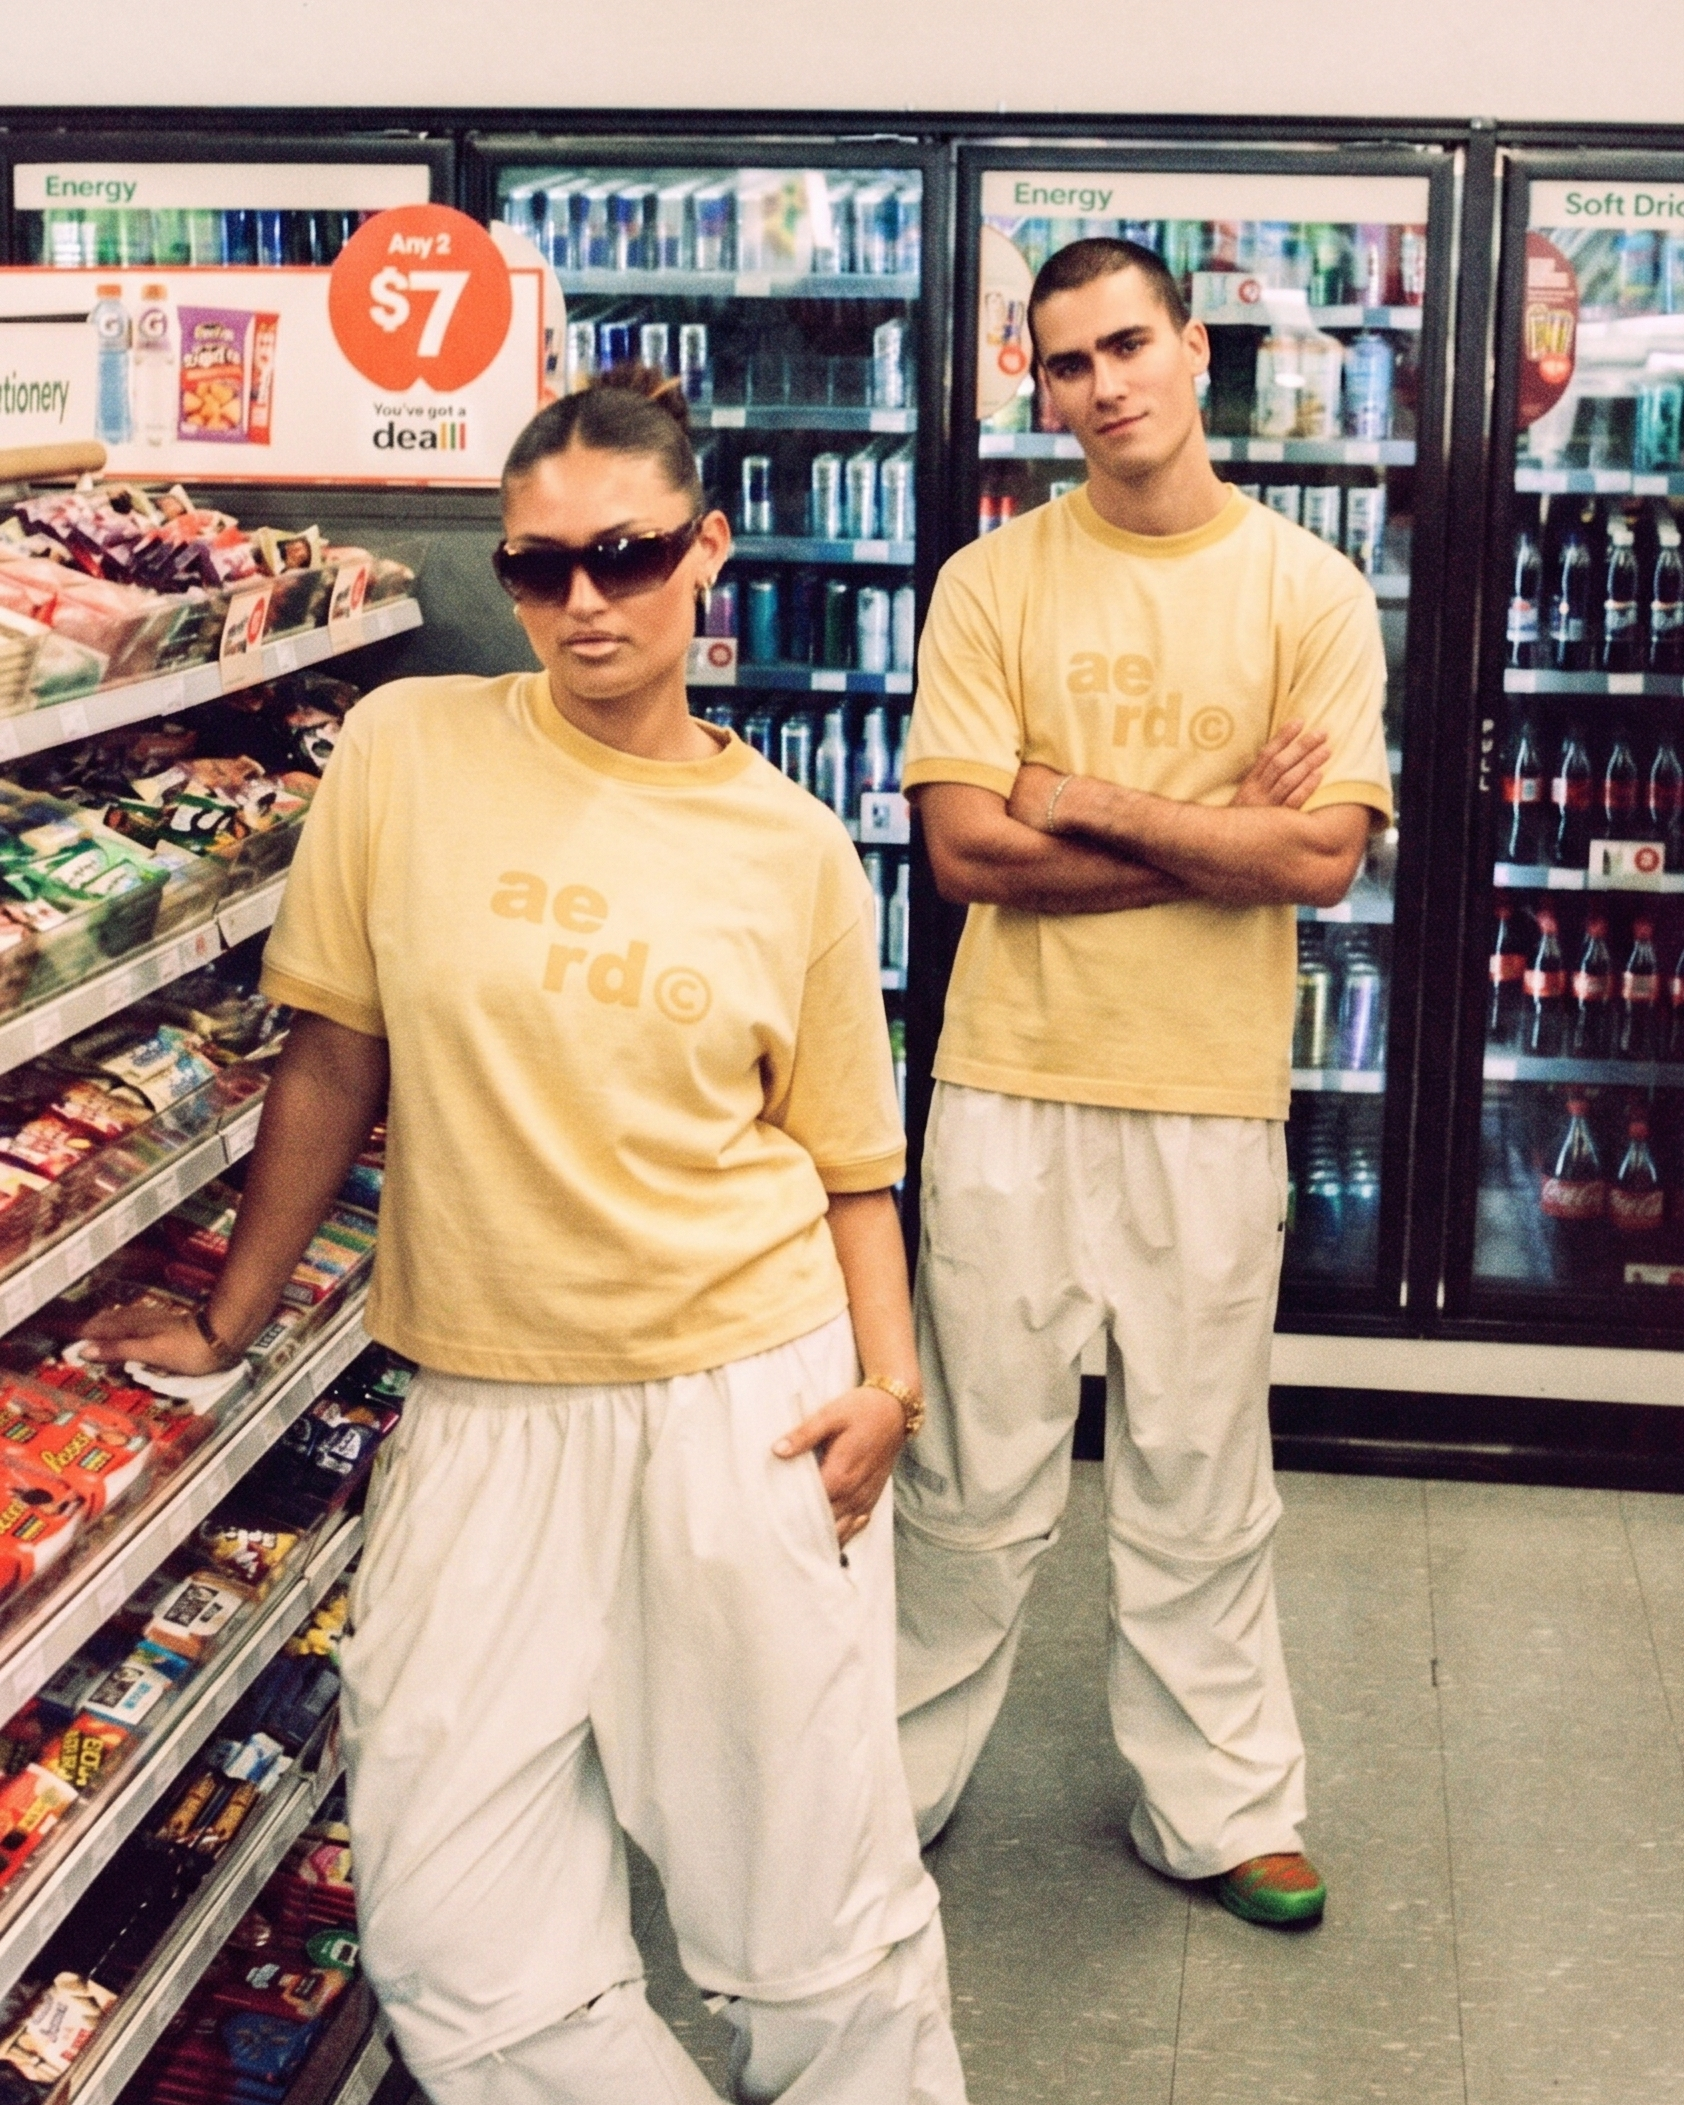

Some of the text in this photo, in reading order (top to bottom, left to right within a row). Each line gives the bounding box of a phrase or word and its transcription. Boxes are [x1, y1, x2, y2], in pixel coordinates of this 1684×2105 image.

[45, 174, 137, 203] Energy
[1014, 182, 1113, 212] Energy
[1565, 192, 1625, 216] Soft
[387, 232, 451, 260] Any 2
[368, 265, 472, 359] $7
[0, 370, 70, 425] tionery
[373, 402, 467, 420] You've got a
[1066, 652, 1155, 697] ae
[1479, 718, 1495, 792] PULL
[490, 869, 610, 936] ae
